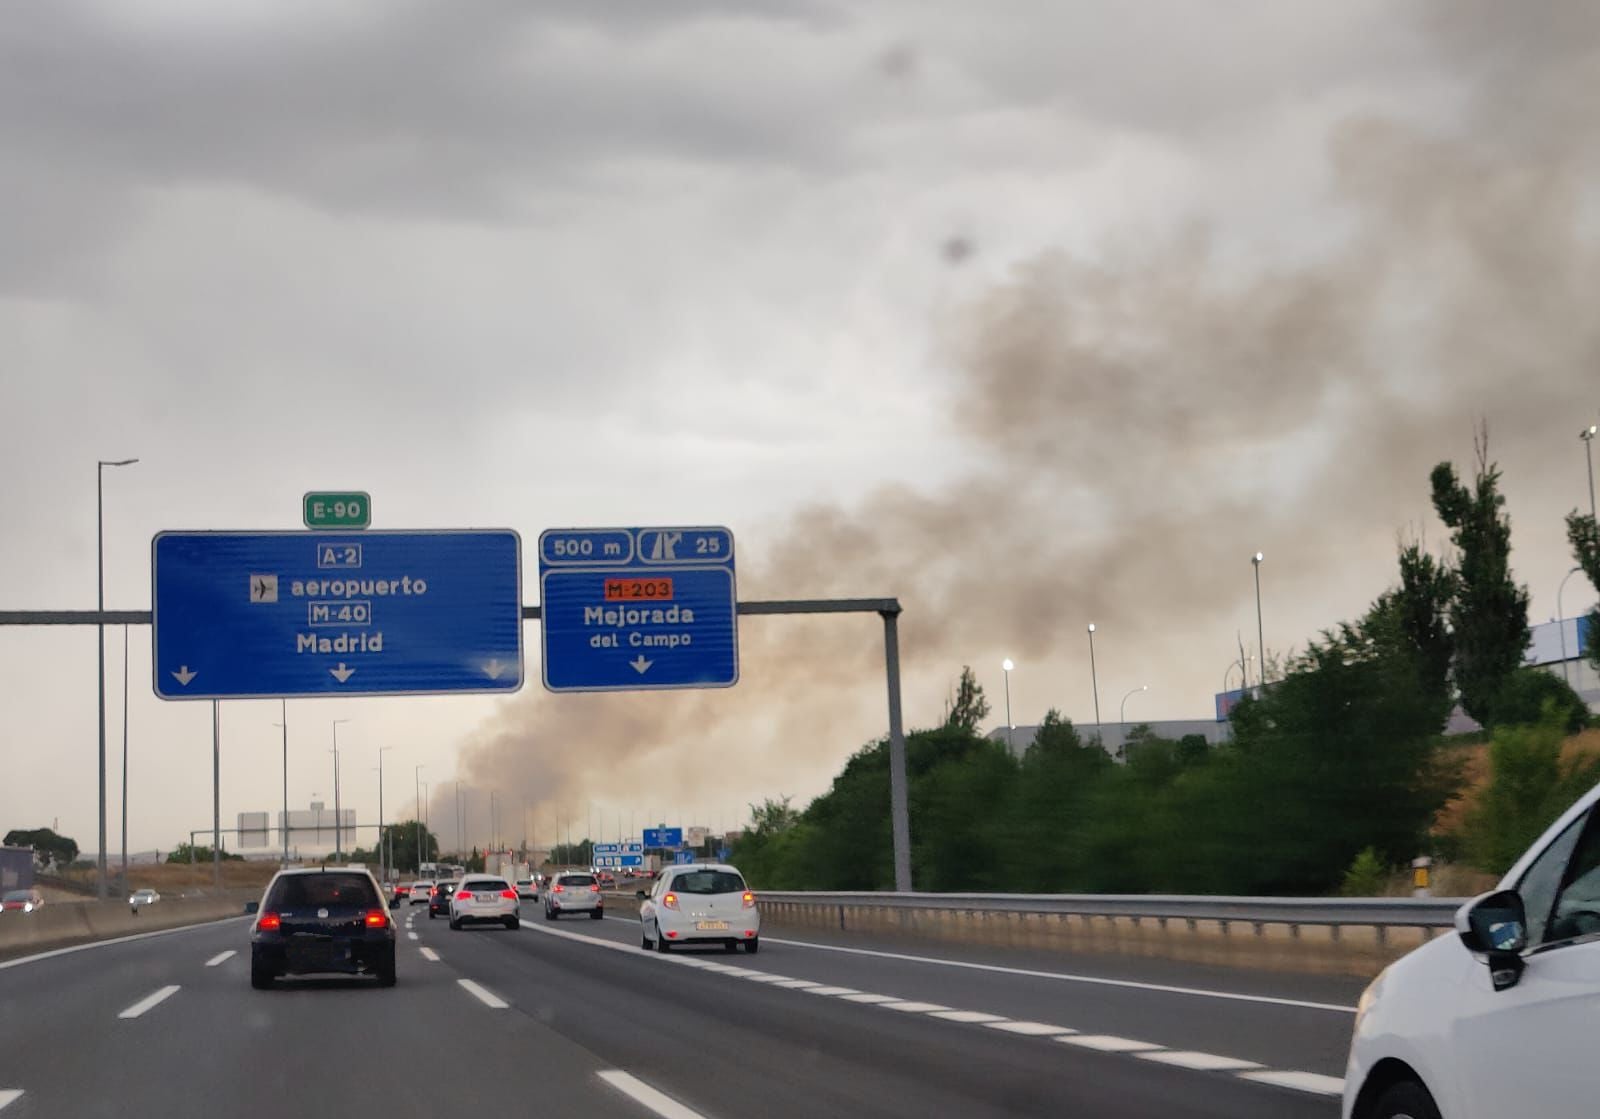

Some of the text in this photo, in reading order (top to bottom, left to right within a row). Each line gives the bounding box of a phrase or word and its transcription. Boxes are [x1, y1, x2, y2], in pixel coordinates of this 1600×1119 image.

[312, 501, 361, 518] E-90
[554, 539, 620, 556] 500 m
[696, 538, 720, 553] 25
[323, 548, 357, 564] A-2
[291, 576, 427, 598] aeropuerto
[608, 582, 669, 597] M-203
[312, 605, 366, 622] M-40
[584, 605, 694, 627] Mejorada
[296, 632, 383, 653] Madrid
[590, 632, 691, 648] del Campo
